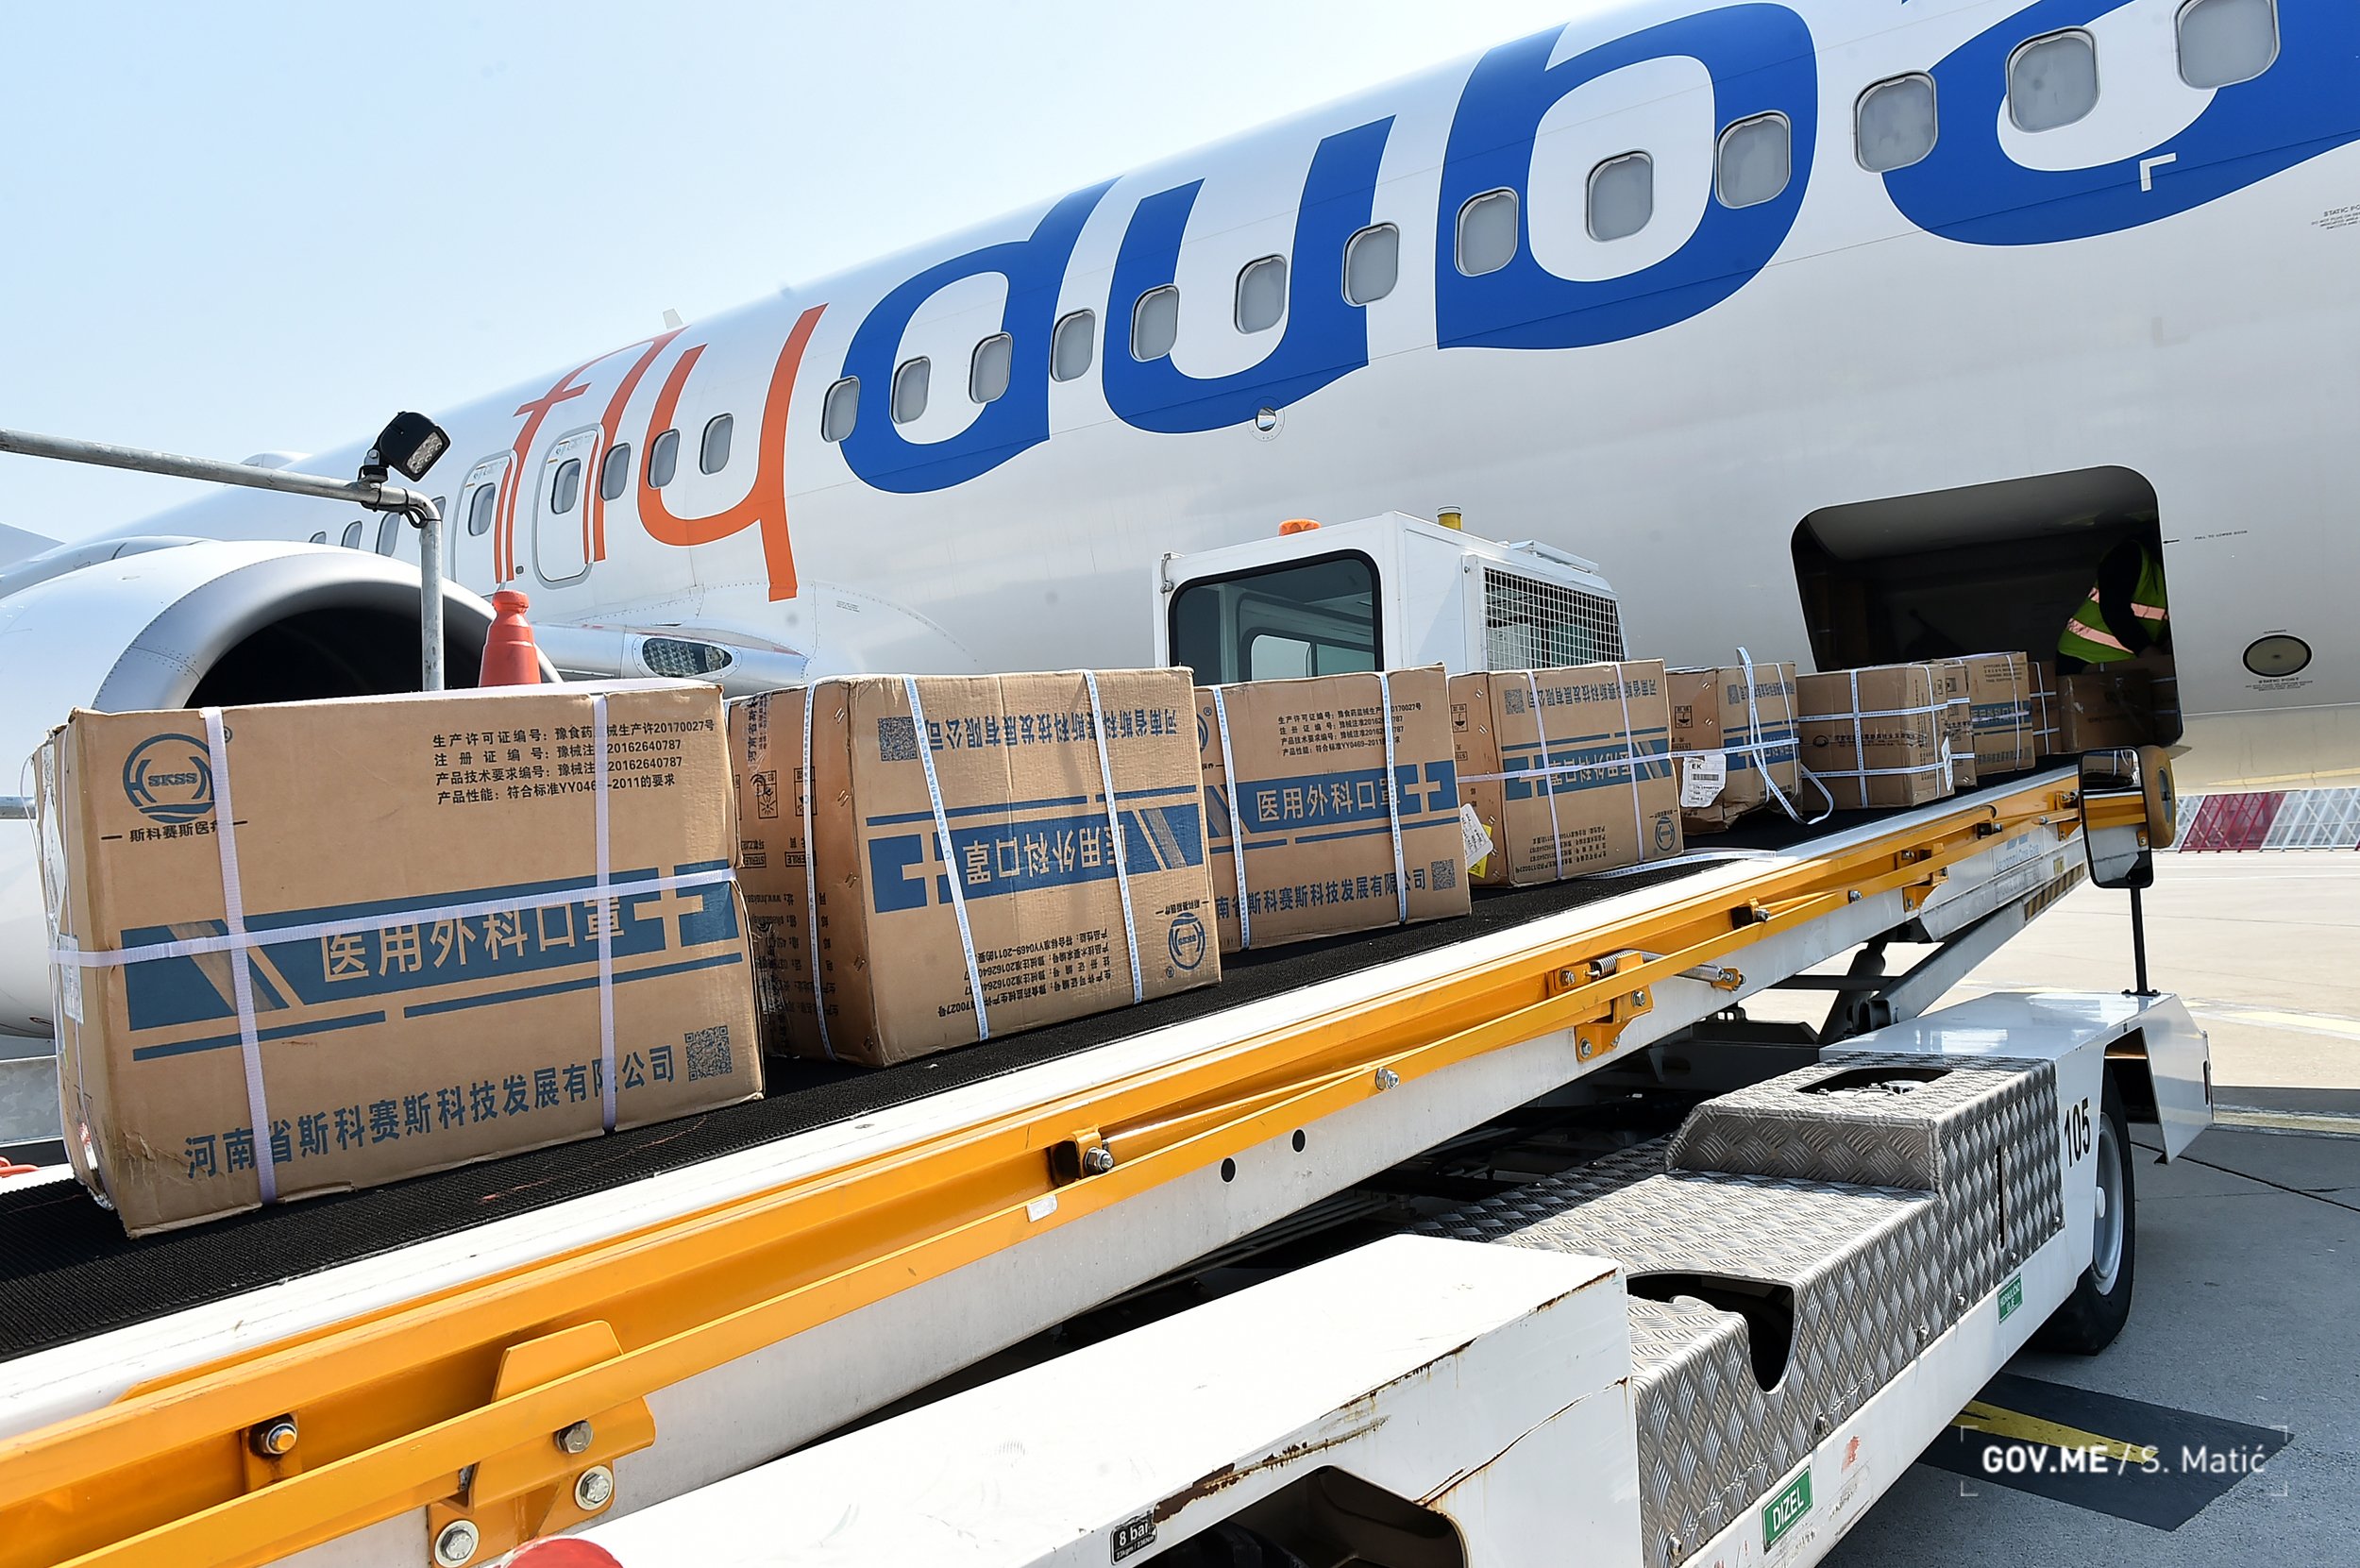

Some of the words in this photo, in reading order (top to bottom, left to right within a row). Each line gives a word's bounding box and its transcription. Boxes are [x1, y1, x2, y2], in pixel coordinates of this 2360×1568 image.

[148, 772, 197, 787] SKSS
[2064, 1097, 2091, 1169] 105
[1772, 1486, 1805, 1533] DIZEL
[1119, 1530, 1127, 1546] 8
[1130, 1523, 1150, 1542] bar
